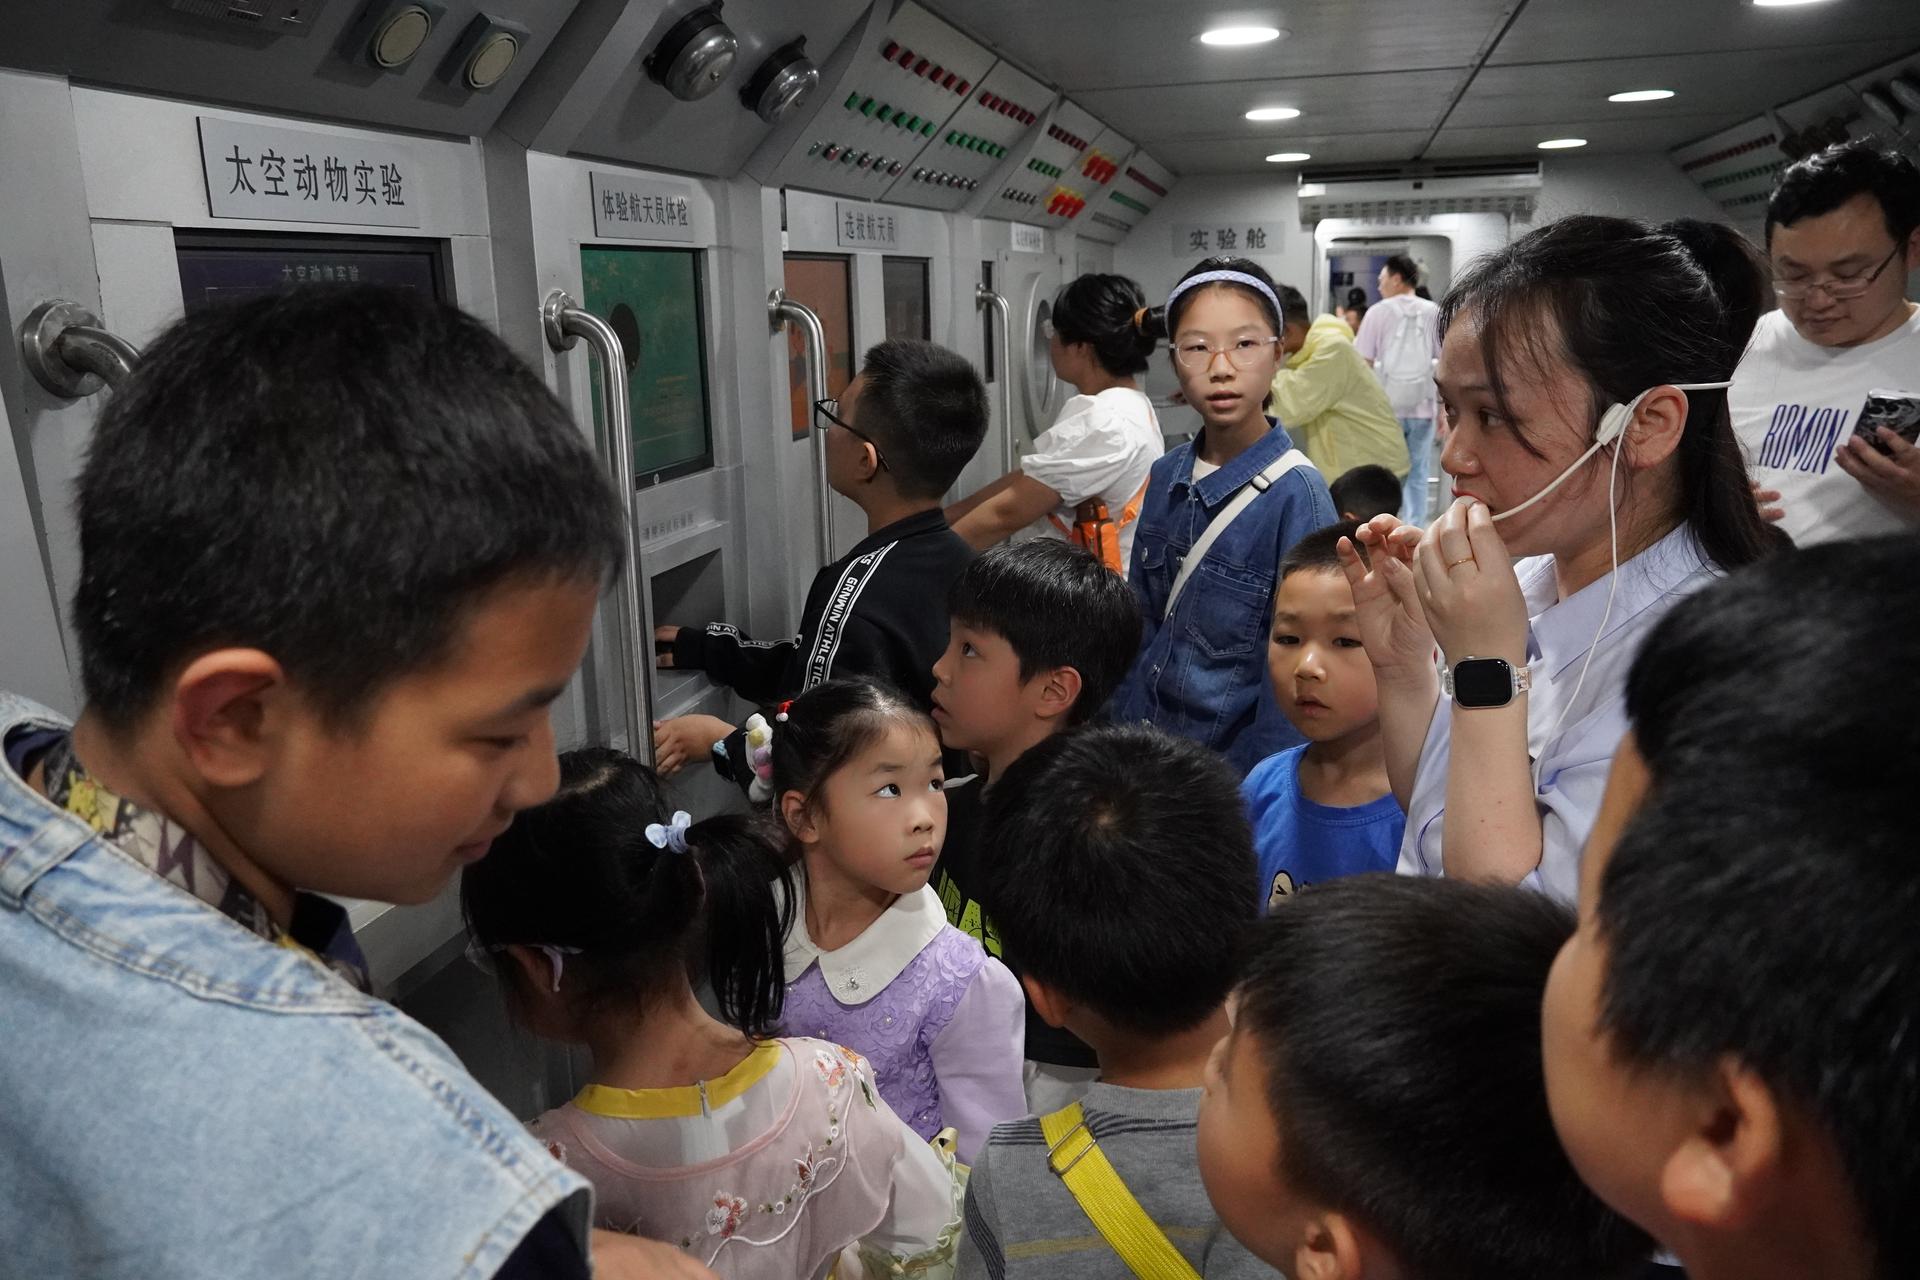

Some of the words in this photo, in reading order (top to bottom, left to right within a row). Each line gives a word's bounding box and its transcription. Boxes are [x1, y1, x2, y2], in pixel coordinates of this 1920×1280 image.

[225, 145, 405, 206] 太空动物实验
[602, 189, 688, 227] 体验航天员体检
[1190, 228, 1266, 251] 实验舱
[828, 576, 859, 622] GRNWIN
